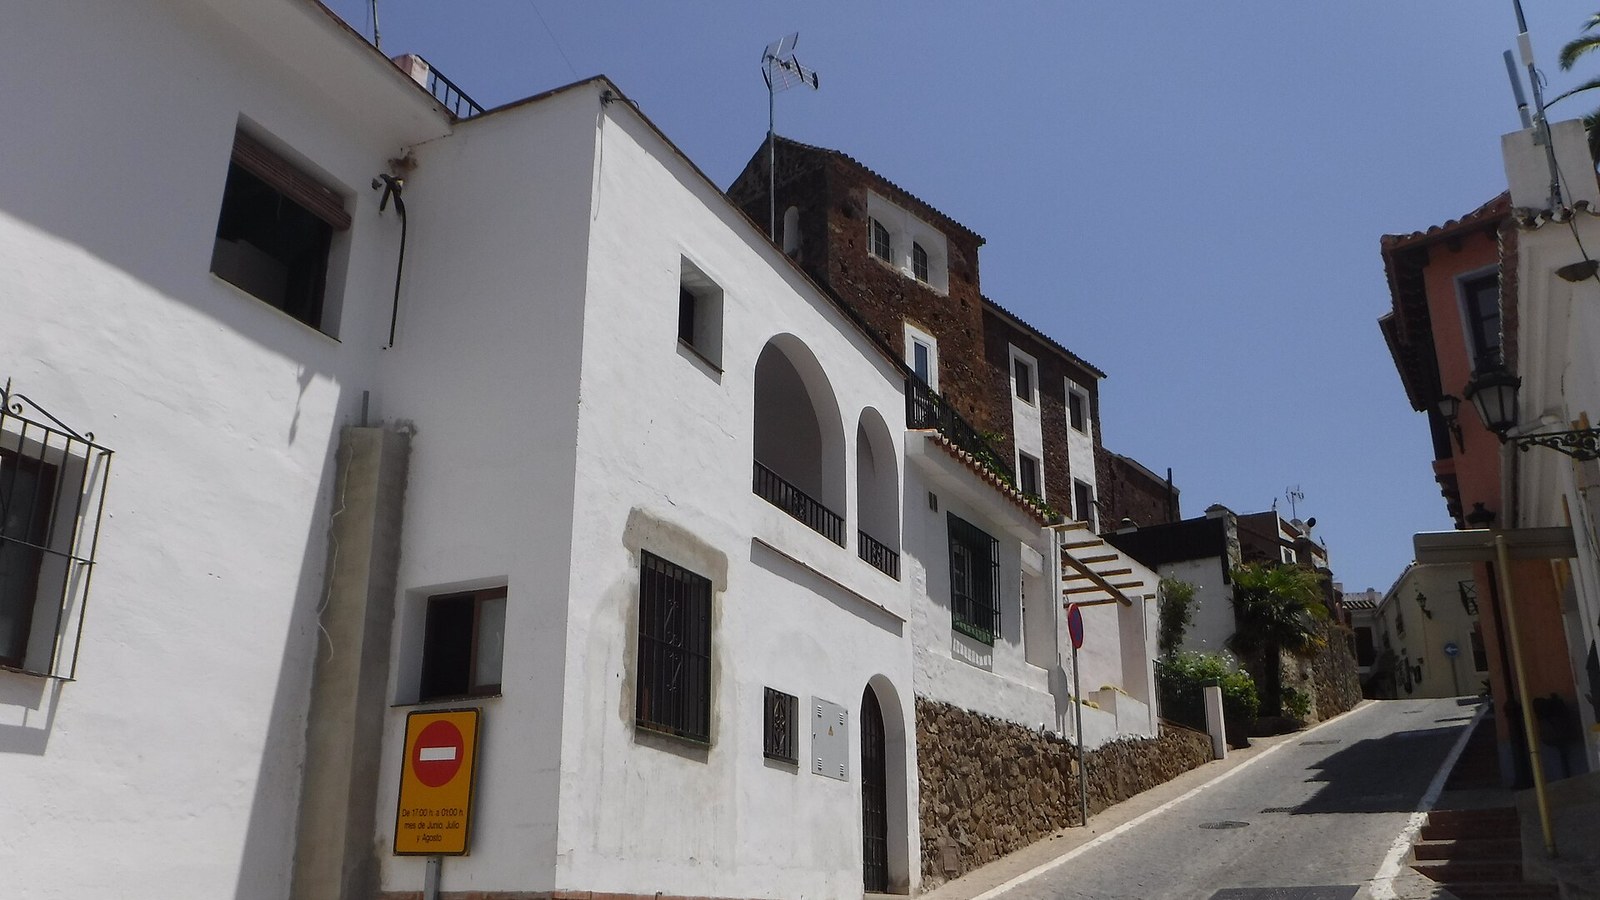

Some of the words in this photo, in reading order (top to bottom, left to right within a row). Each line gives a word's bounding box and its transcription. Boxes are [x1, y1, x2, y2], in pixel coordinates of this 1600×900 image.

[402, 808, 411, 817] De
[404, 822, 416, 830] mes
[418, 821, 425, 830] de
[446, 821, 460, 830] Julio
[422, 833, 442, 844] Agosto
